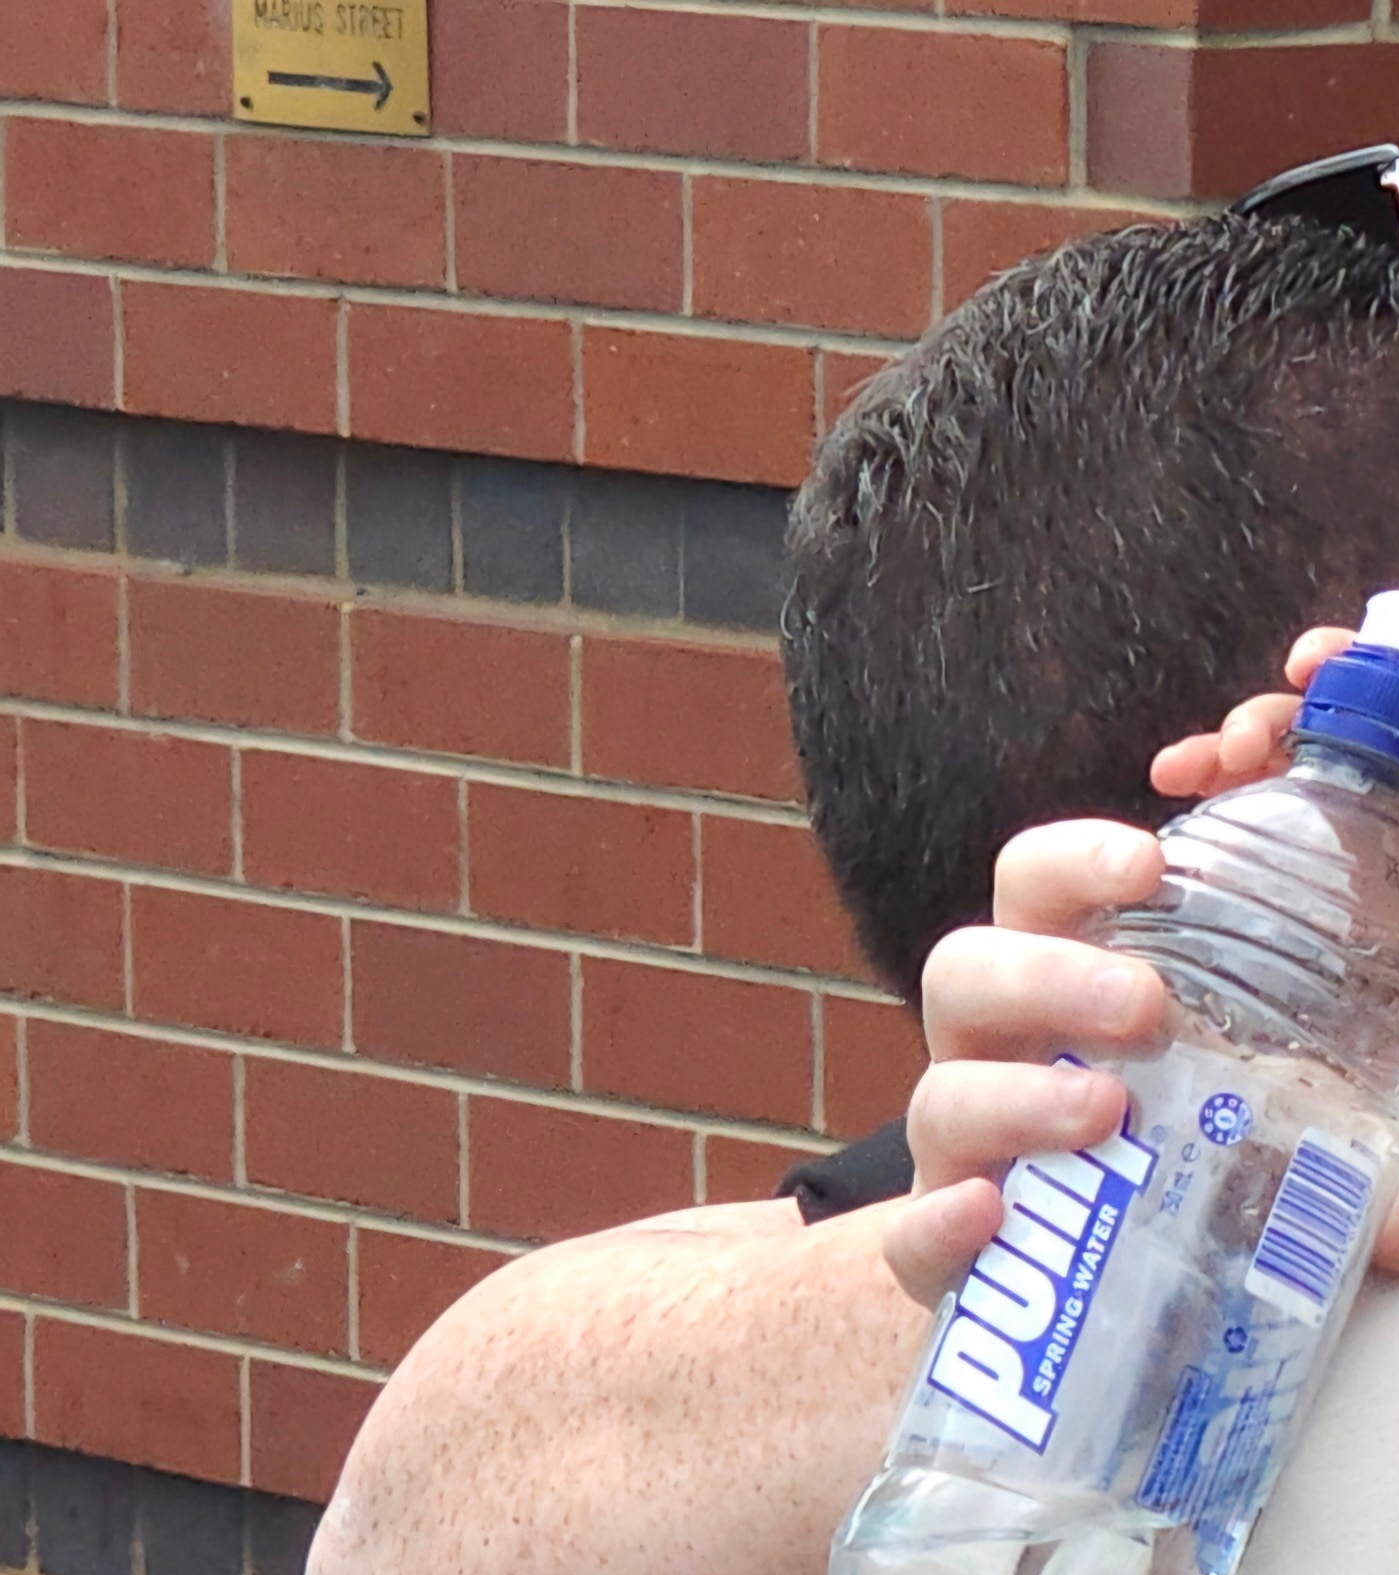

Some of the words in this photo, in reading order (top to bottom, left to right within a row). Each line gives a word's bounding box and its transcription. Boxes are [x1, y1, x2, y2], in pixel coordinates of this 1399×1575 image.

[336, 3, 404, 40] STREET
[928, 1053, 1160, 1456] pum
[1032, 1292, 1084, 1398] SPRING
[1072, 1202, 1120, 1295] WATER
